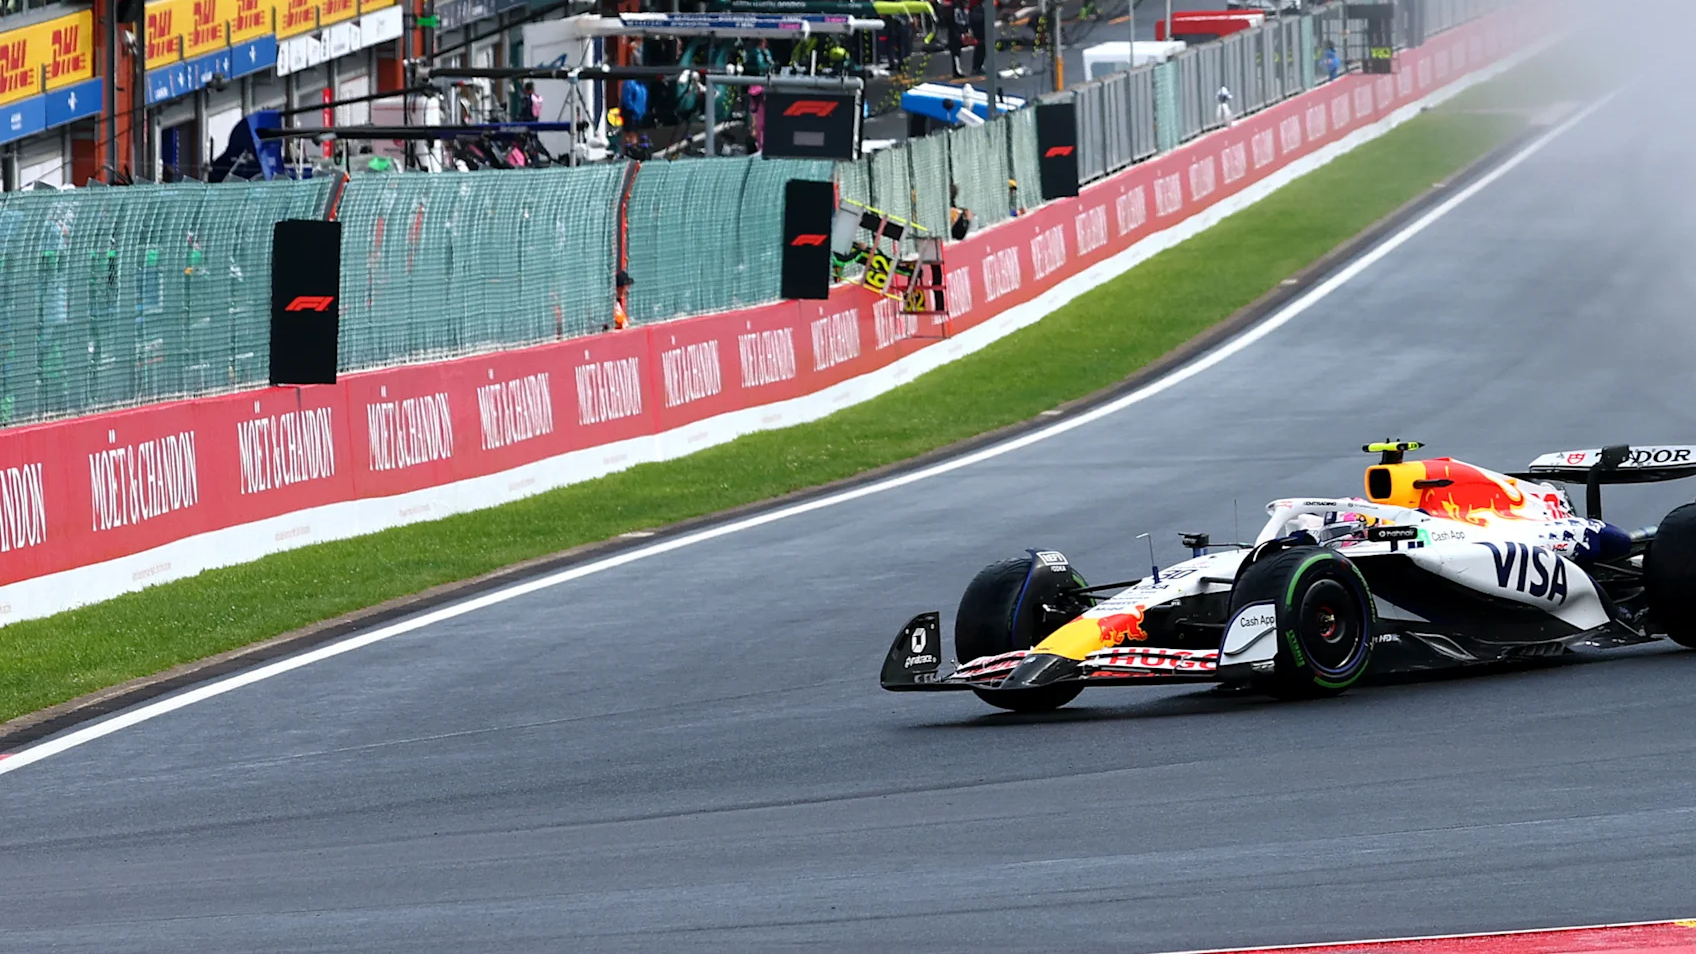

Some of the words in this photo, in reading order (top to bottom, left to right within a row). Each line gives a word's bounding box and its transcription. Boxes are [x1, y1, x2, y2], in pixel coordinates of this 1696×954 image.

[284, 296, 334, 311] F1
[237, 401, 272, 494] MOËT
[271, 414, 282, 489] &
[280, 407, 335, 485] CHANDON
[89, 429, 128, 531] MOËT
[127, 444, 141, 526] &
[138, 430, 198, 522] CHANDON
[1431, 531, 1450, 541] Cash
[1451, 530, 1465, 541] App
[1472, 542, 1568, 606] VISA
[1240, 617, 1259, 628] Cash
[1260, 615, 1275, 628] App
[904, 654, 932, 668] dynatrace
